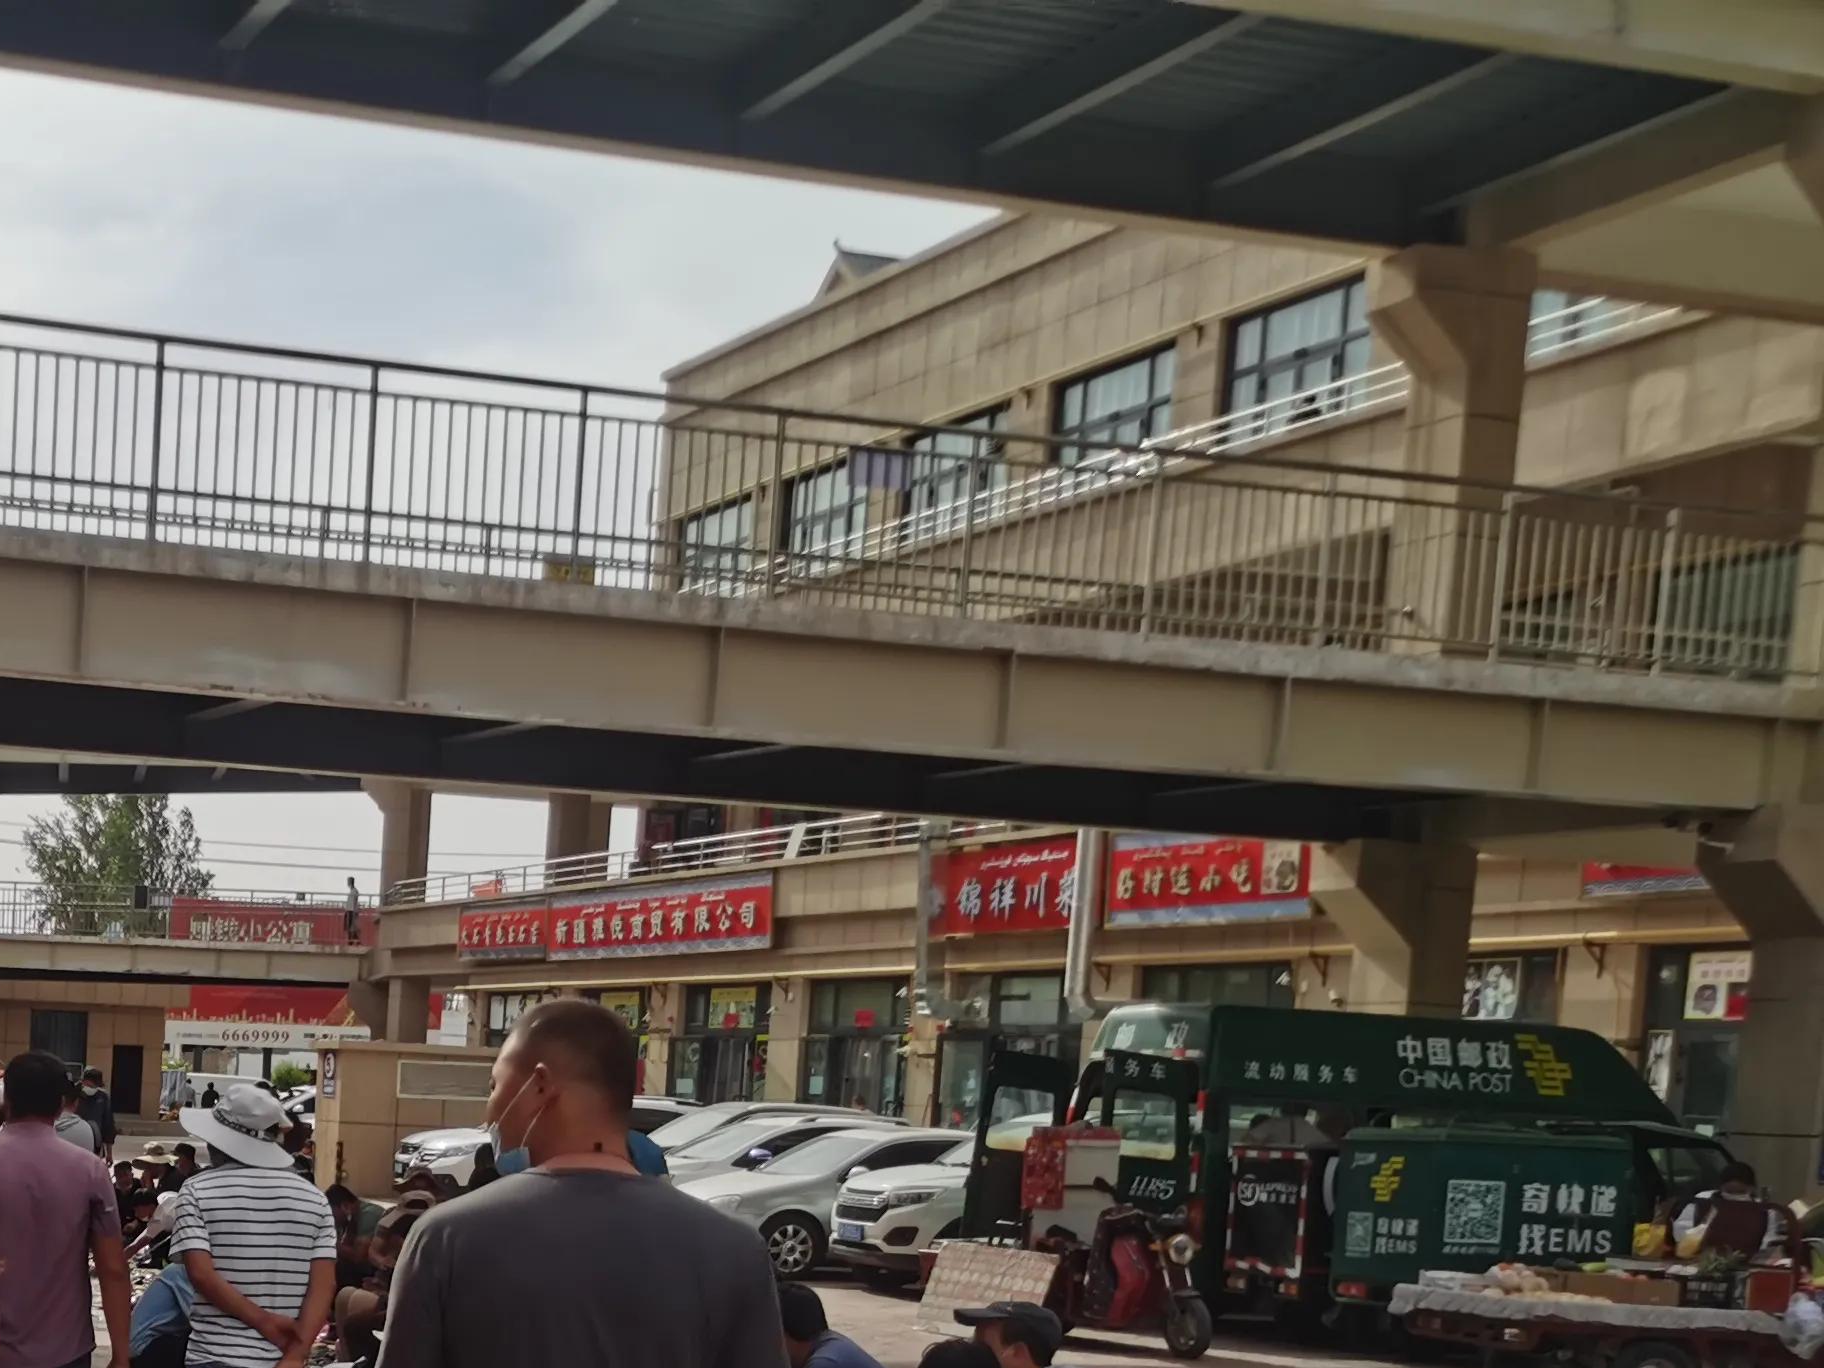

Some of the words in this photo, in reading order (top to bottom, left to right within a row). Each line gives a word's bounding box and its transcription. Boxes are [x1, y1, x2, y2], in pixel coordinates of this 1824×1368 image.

[1396, 1033, 1513, 1070] 中国邮政
[1244, 1060, 1360, 1085] 流动服务车
[1398, 1068, 1464, 1092] CHINA
[1468, 1072, 1513, 1094] POST
[1521, 1182, 1618, 1217] 寄快递
[1517, 1223, 1613, 1255] 找EMS
